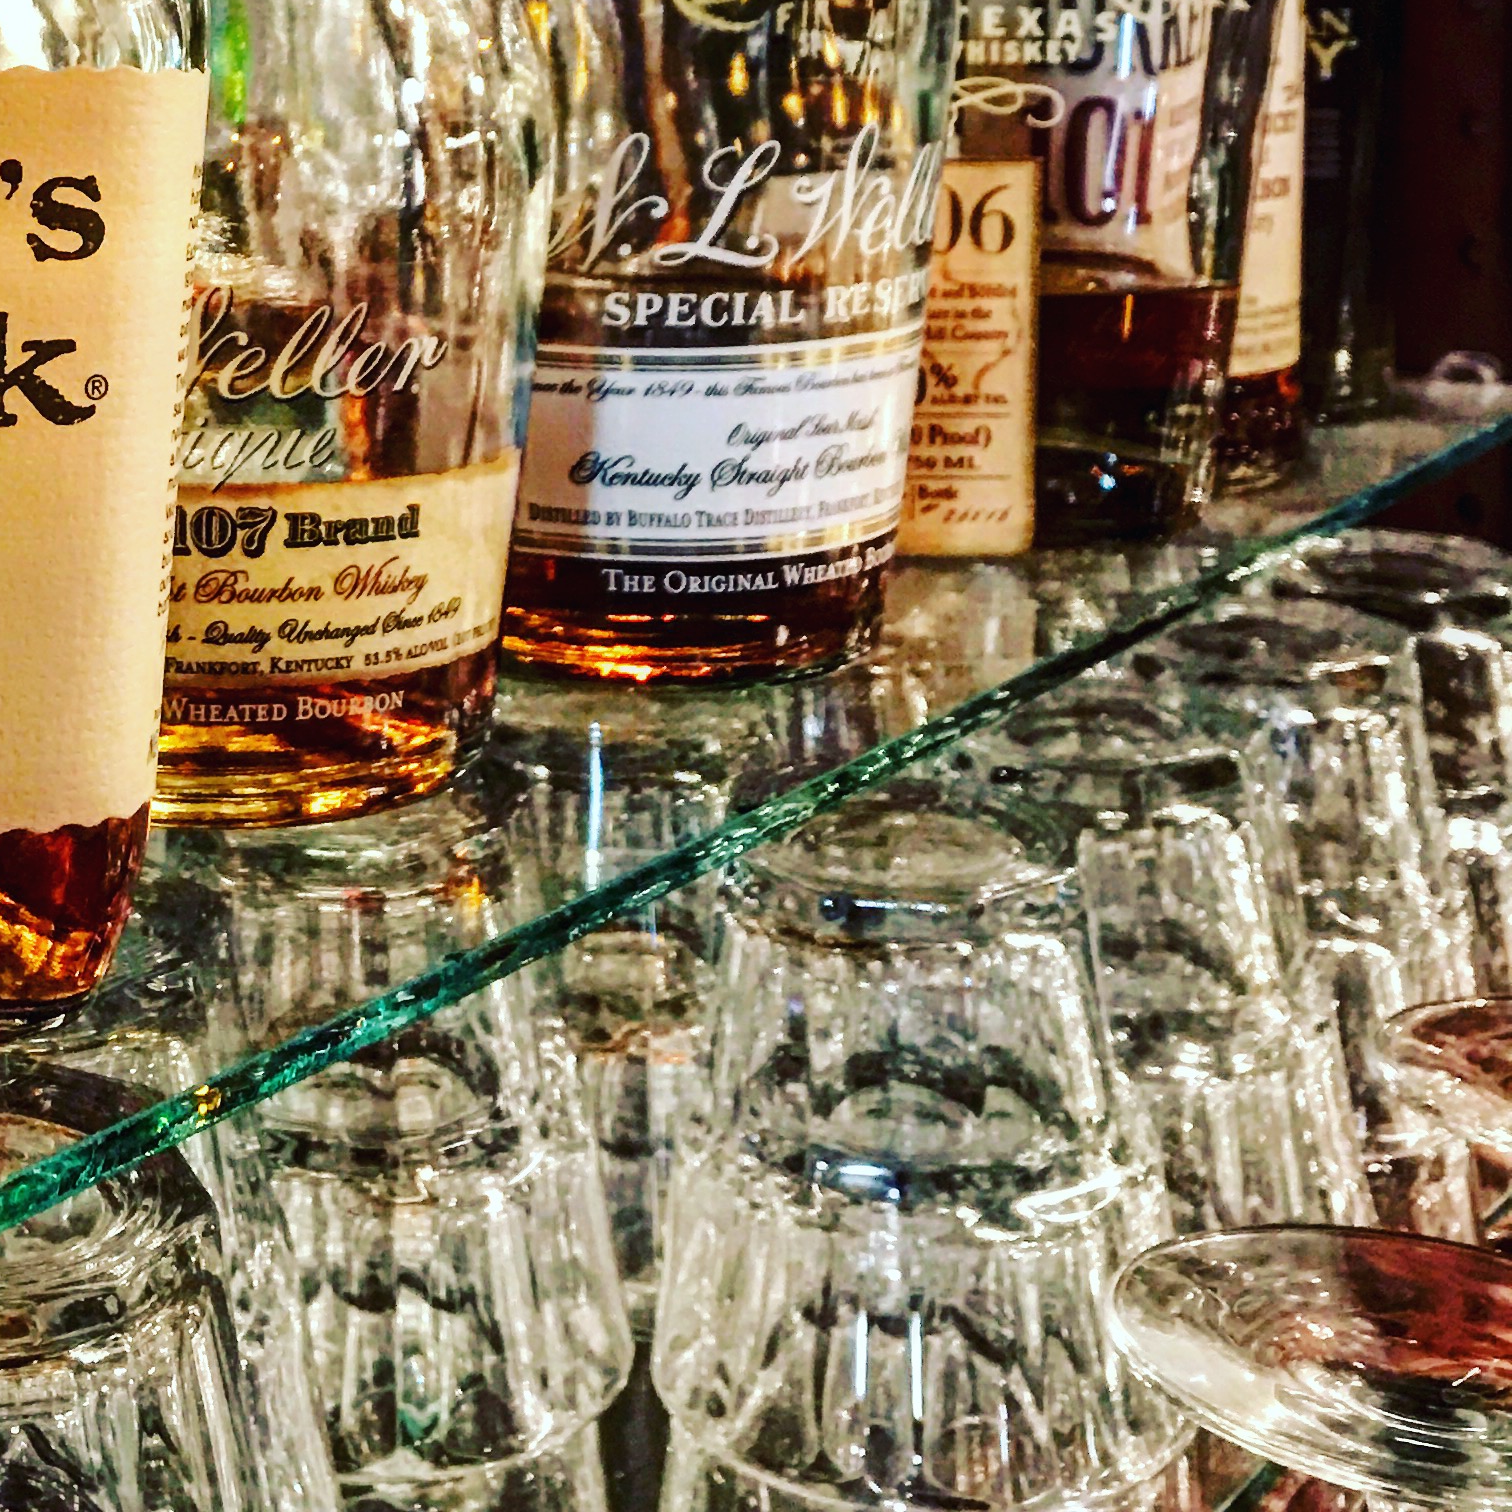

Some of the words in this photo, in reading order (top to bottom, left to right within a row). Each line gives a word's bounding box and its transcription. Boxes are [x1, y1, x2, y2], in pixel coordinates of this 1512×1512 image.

[960, 4, 1120, 41] EXAS
[600, 286, 805, 329] SPECIAL
[643, 376, 694, 398] 1849
[568, 450, 701, 501] Kentucky
[710, 454, 811, 498] Straight
[172, 504, 278, 560] 107
[282, 503, 421, 552] Brand
[194, 568, 326, 607] Bourbon
[202, 619, 273, 654] Quality
[277, 614, 378, 649] Unchanged
